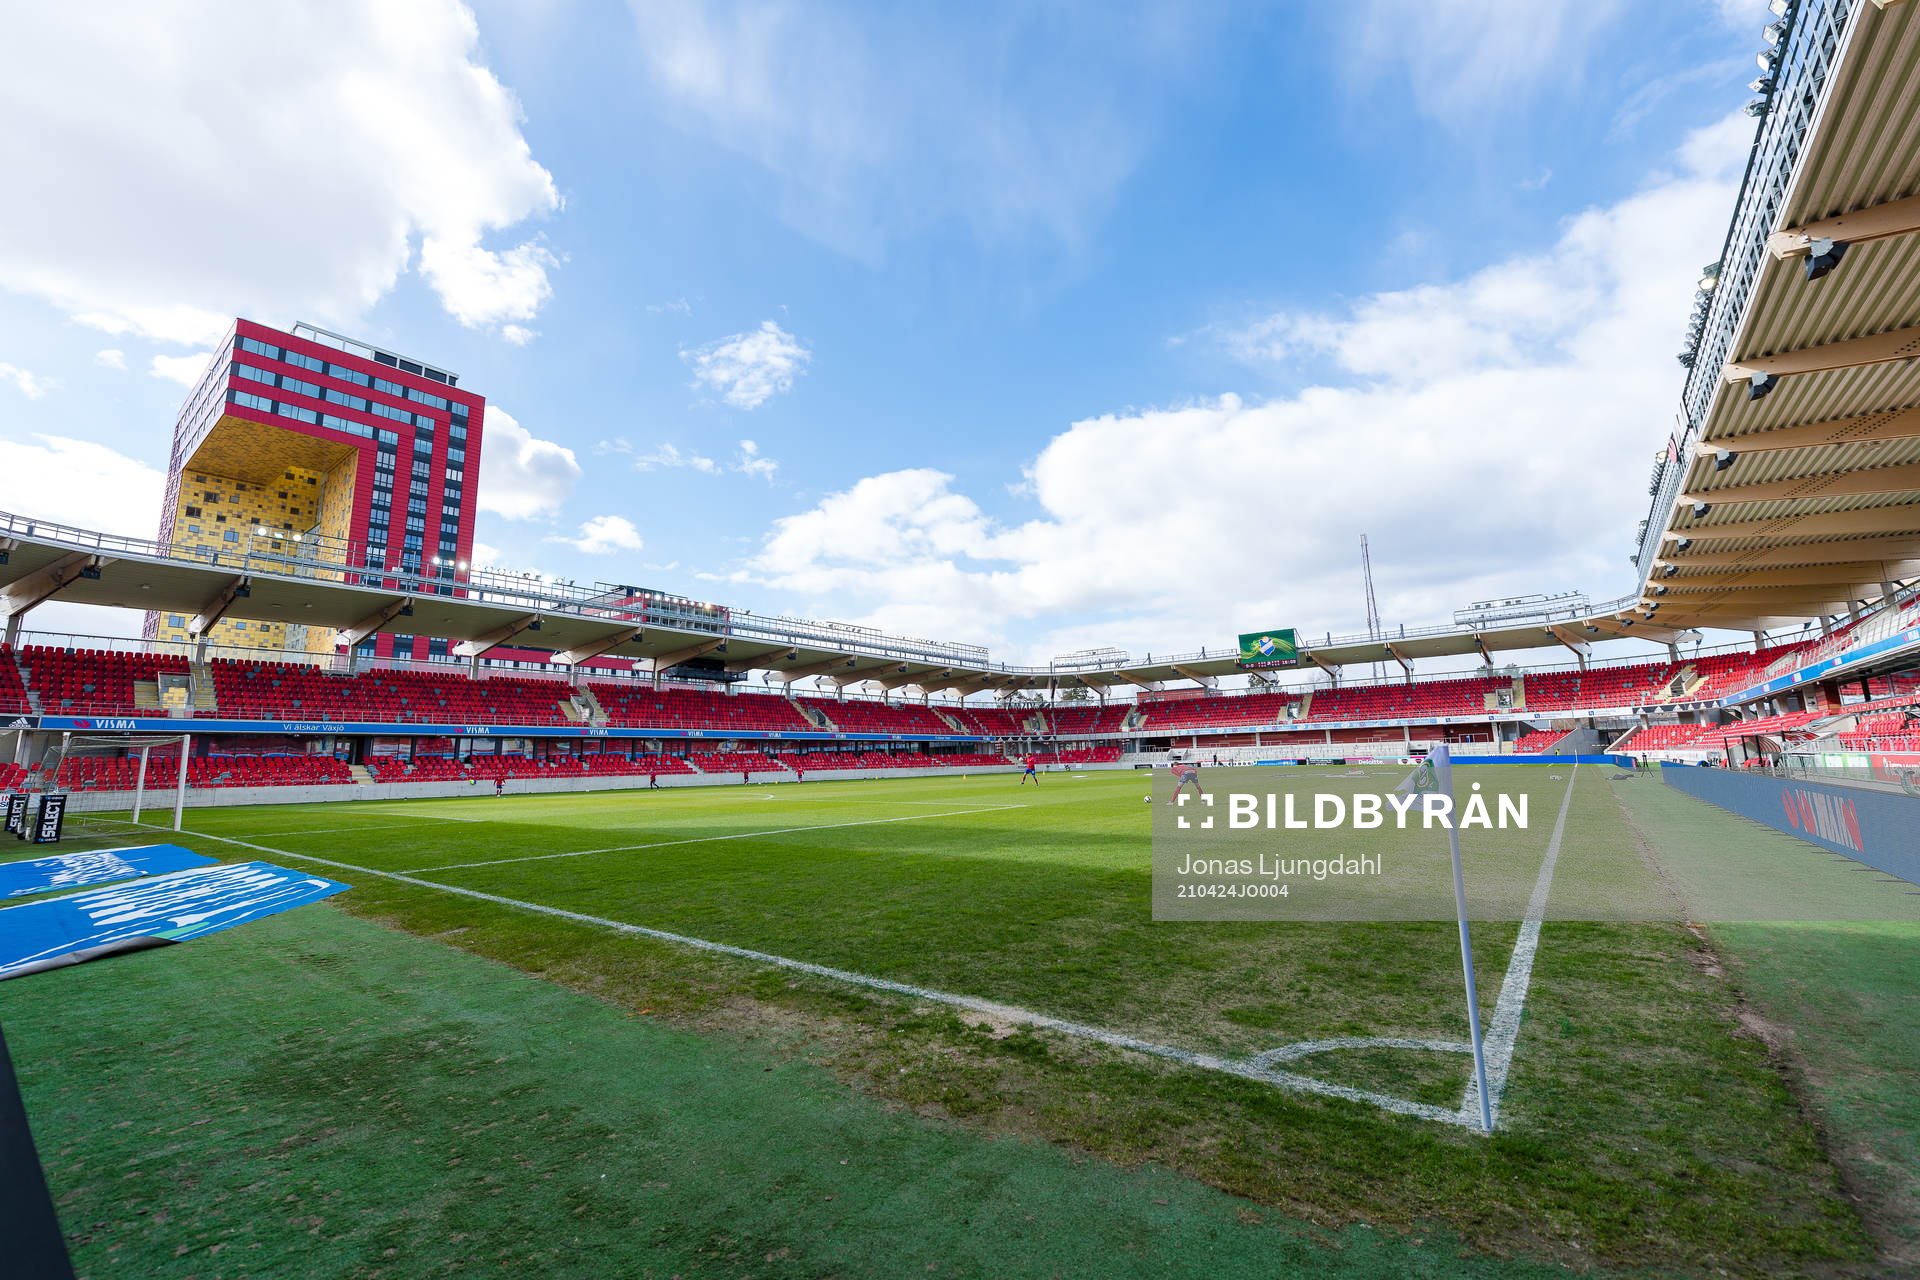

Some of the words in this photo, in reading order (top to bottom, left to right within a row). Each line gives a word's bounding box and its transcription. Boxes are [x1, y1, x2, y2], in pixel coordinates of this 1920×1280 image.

[95, 719, 136, 729] VISMA
[466, 726, 490, 734] VISMA
[41, 801, 61, 838] SELECT
